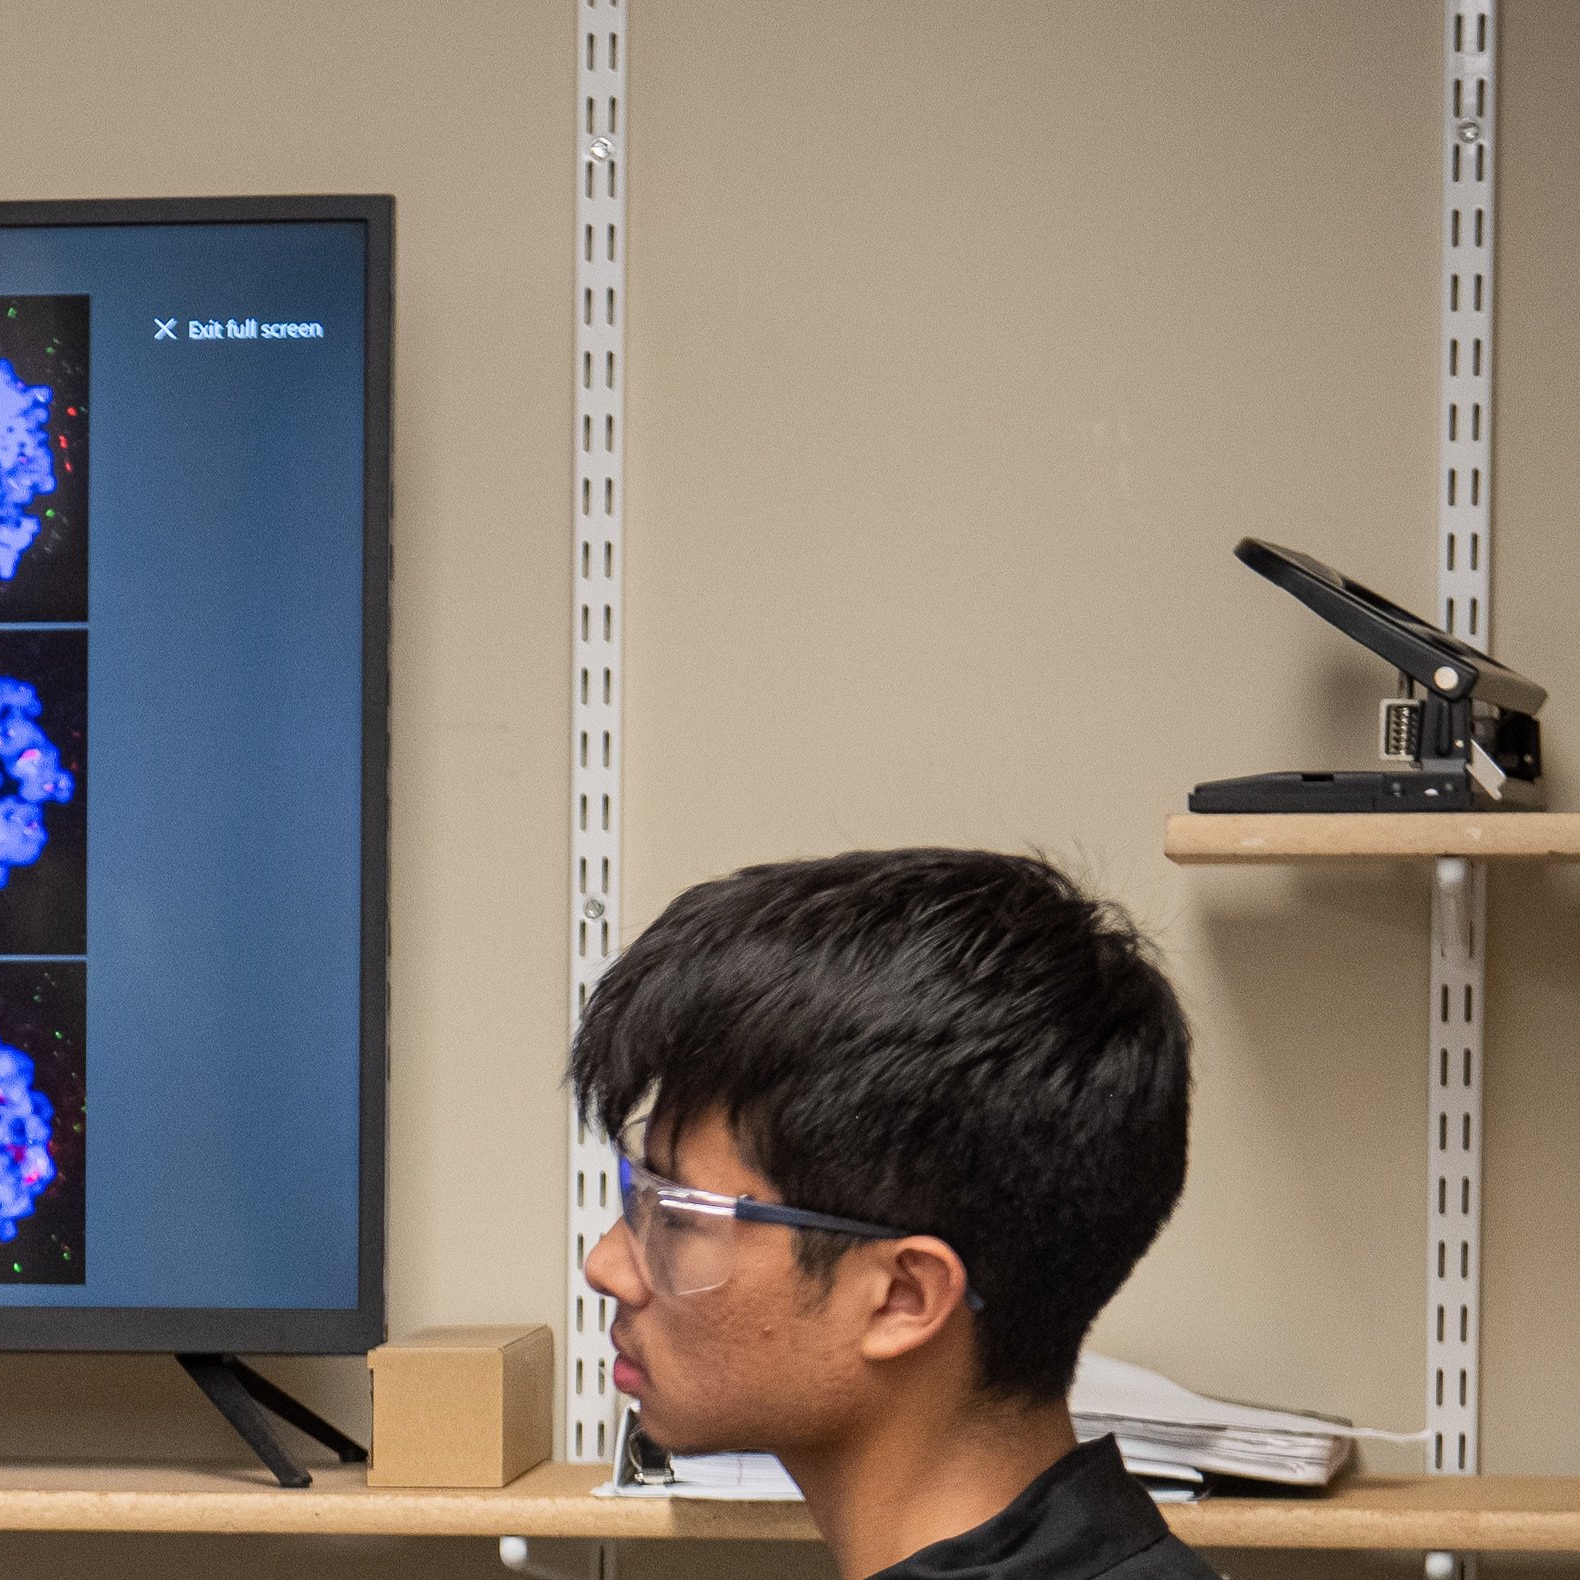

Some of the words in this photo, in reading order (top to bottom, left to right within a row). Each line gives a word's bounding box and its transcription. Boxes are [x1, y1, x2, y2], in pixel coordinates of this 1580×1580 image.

[188, 319, 224, 340] Exit
[225, 318, 258, 339] full
[260, 321, 324, 339] screen
